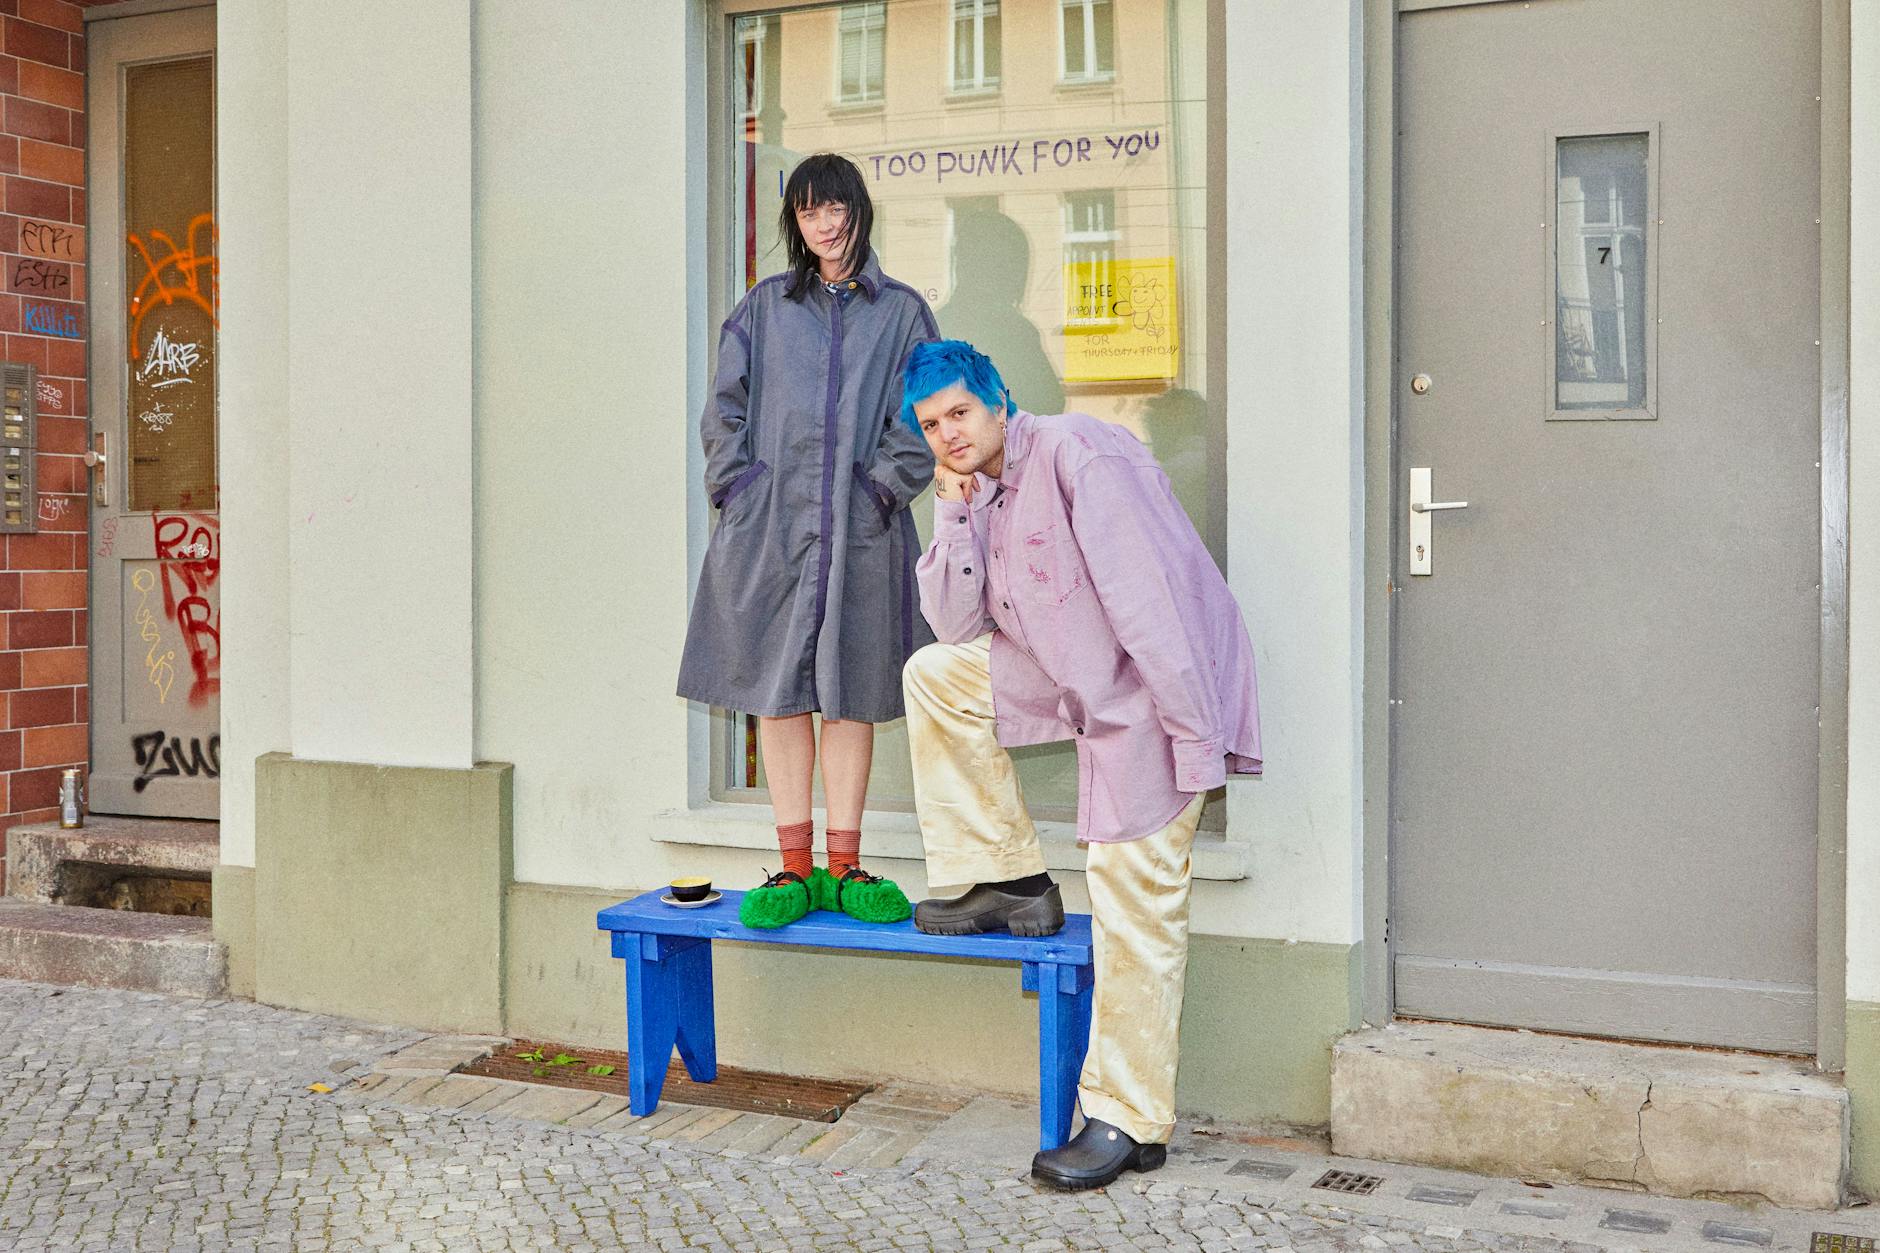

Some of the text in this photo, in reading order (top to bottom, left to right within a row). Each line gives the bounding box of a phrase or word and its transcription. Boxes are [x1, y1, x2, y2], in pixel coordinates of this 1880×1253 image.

[868, 151, 926, 181] TOO
[936, 140, 1024, 184] PUNK
[1033, 137, 1091, 174] FOR
[1104, 130, 1160, 160] YOU
[1597, 247, 1611, 264] 7
[1083, 333, 1110, 346] FOR
[1082, 347, 1132, 359] THURSDAY
[1139, 345, 1179, 357] FRIDAY
